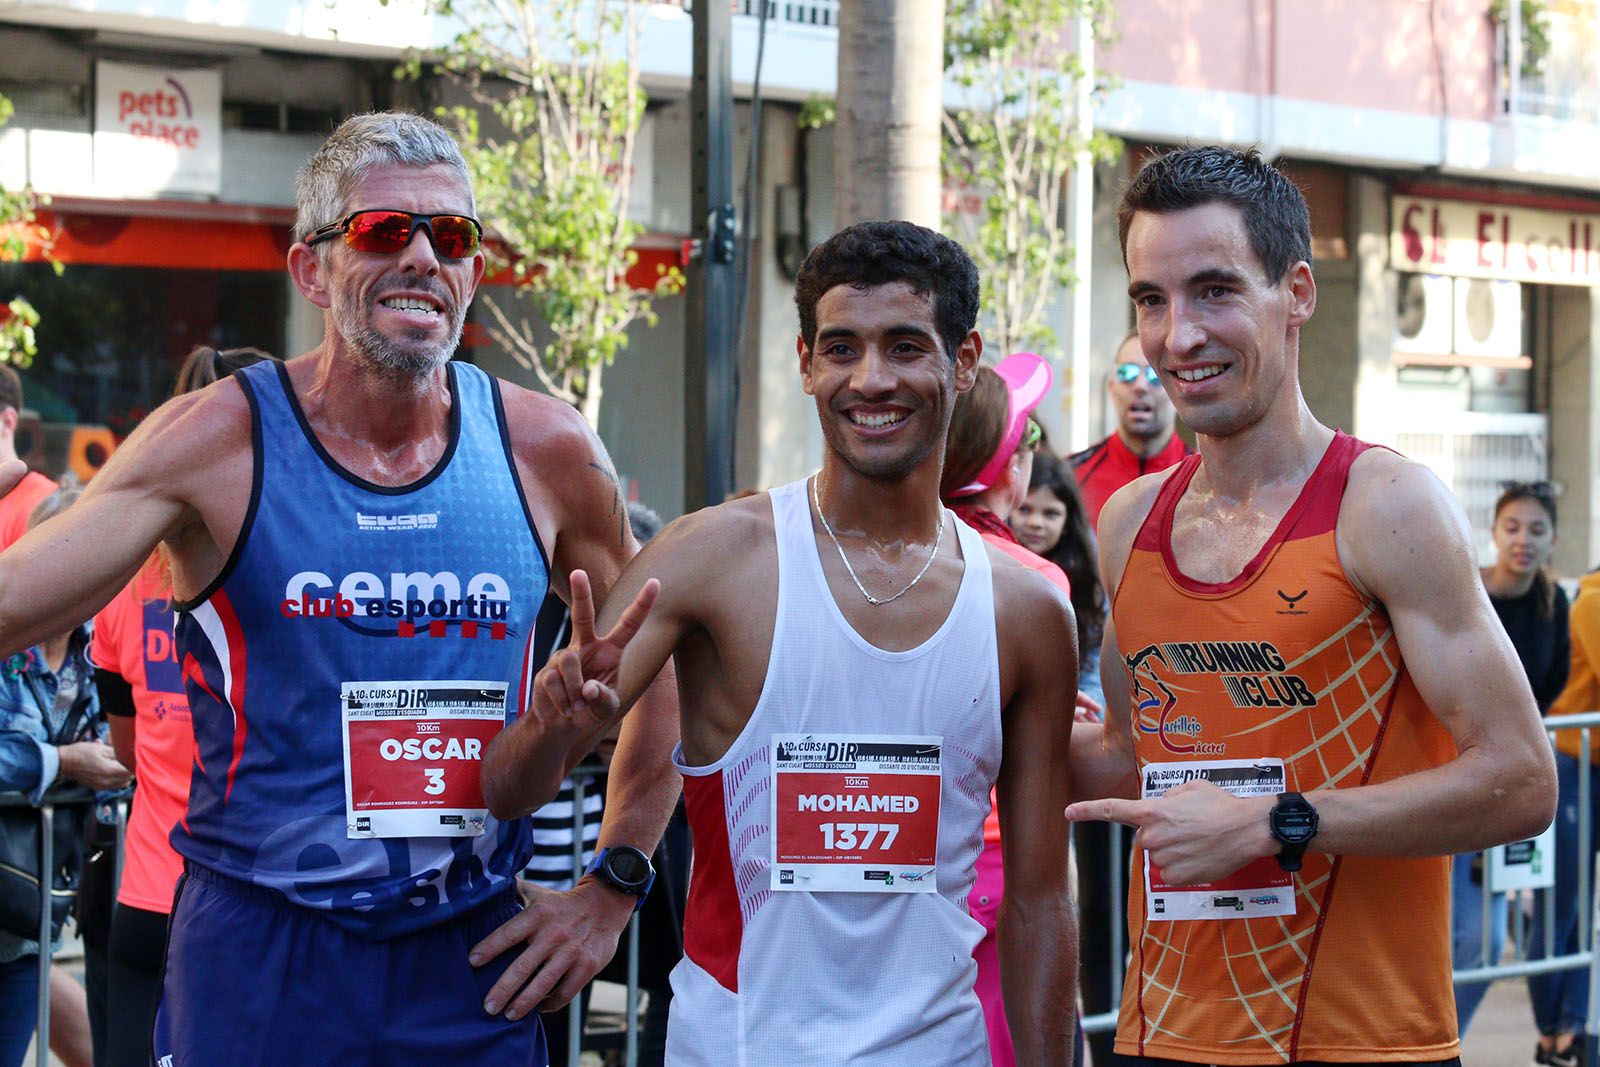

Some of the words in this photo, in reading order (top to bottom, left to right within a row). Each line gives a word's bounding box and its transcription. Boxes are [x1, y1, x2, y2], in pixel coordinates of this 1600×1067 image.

[119, 90, 177, 123] pets
[285, 571, 511, 617] ceme
[280, 593, 354, 619] club
[366, 594, 507, 624] esportiu
[1174, 641, 1286, 673] RUNNING
[370, 689, 397, 699] CURSA
[397, 689, 428, 709] DiR
[1239, 675, 1317, 707] CLUB
[416, 724, 441, 732] 10Km
[380, 738, 482, 761] OSCAR
[799, 742, 827, 752] CURSA
[826, 742, 857, 762] DiR
[423, 768, 446, 795] 3
[844, 778, 869, 787] 10Km
[798, 794, 919, 814] MOHAMED
[819, 822, 900, 850] 1377
